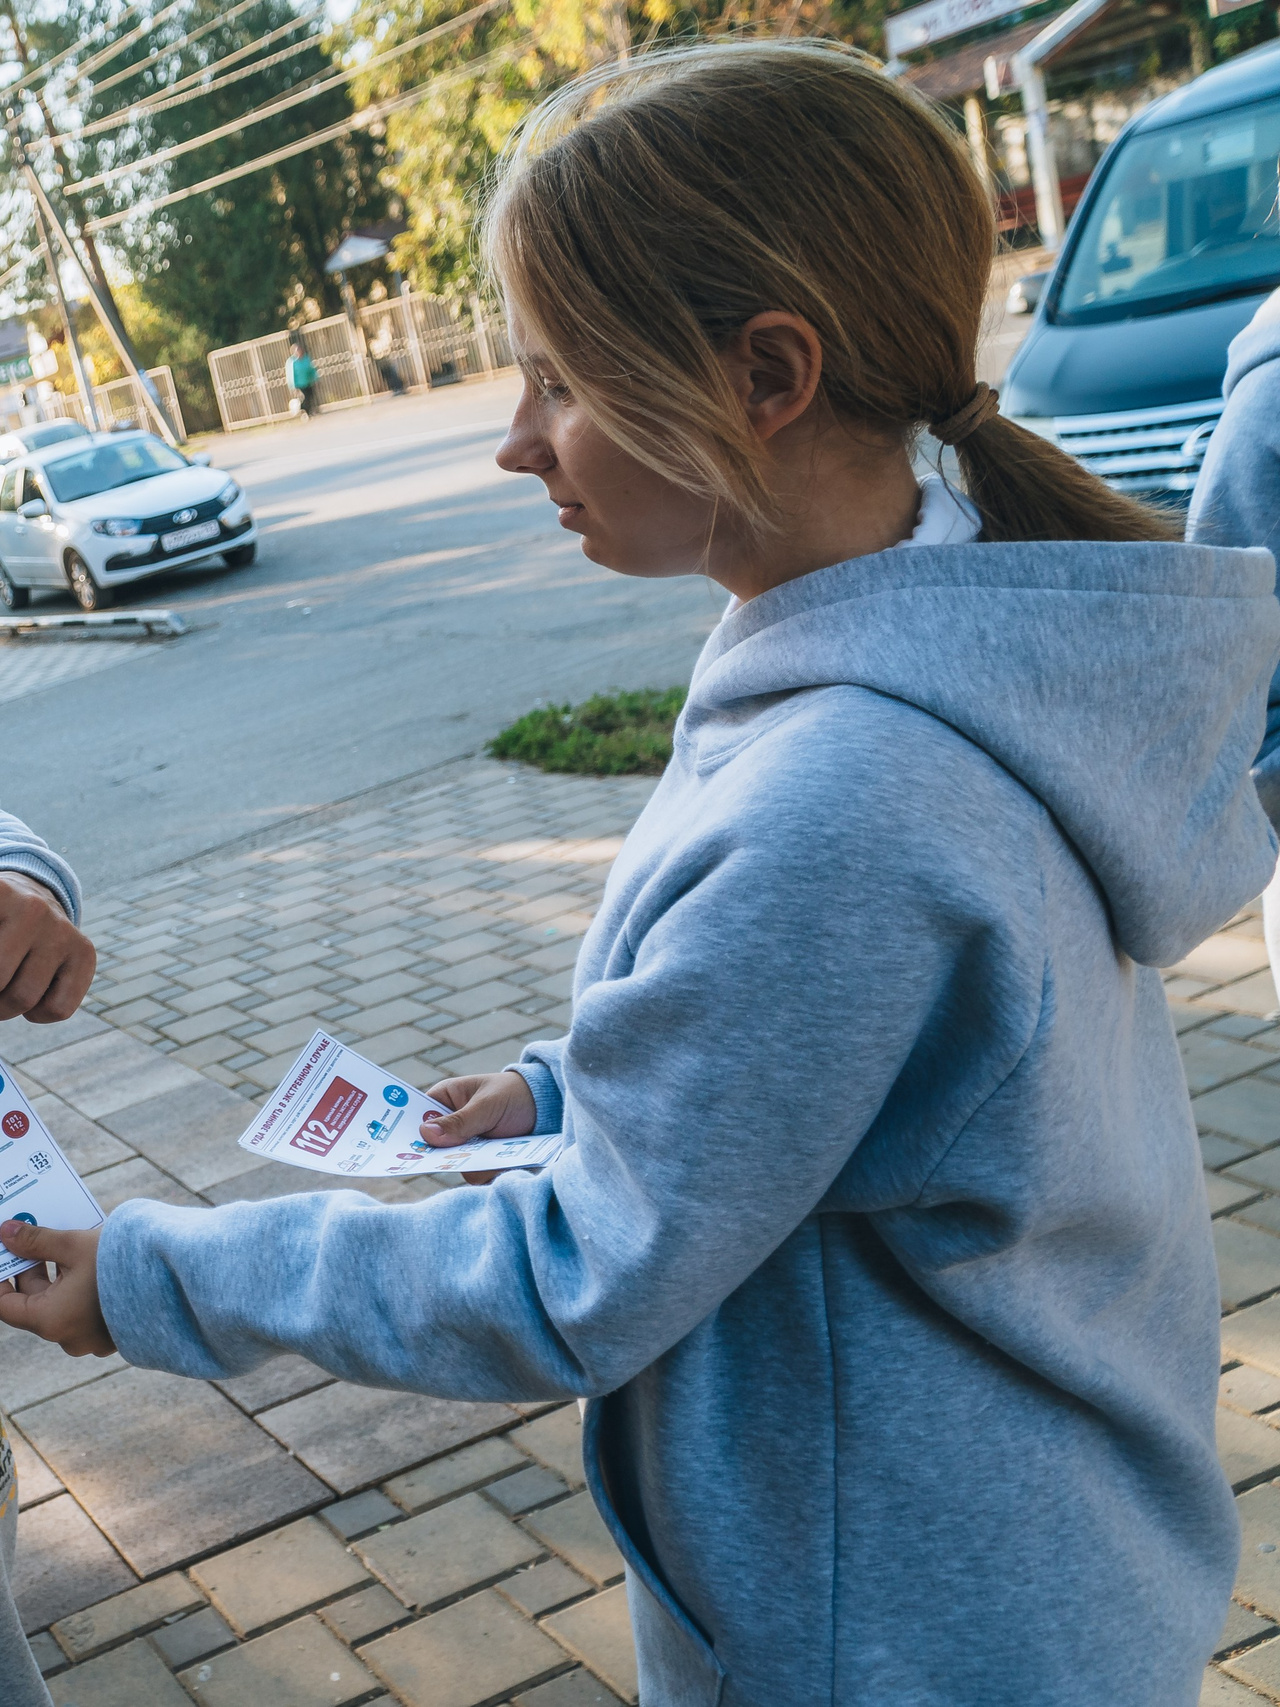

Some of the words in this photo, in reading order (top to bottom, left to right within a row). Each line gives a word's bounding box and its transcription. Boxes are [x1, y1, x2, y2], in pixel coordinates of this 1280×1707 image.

[250, 1129, 266, 1147] КУДА
[261, 1105, 283, 1132] ЗВОНИТЬ
[278, 1100, 286, 1108] В
[282, 1062, 313, 1103] ЭКСТРЕННОМ
[309, 1037, 330, 1064] СЛУЧАЕ
[387, 1088, 402, 1103] 102
[4, 1113, 23, 1127] 101,
[8, 1120, 24, 1133] 112
[296, 1121, 338, 1155] 112
[29, 1150, 47, 1165] 121,
[33, 1158, 49, 1171] 123
